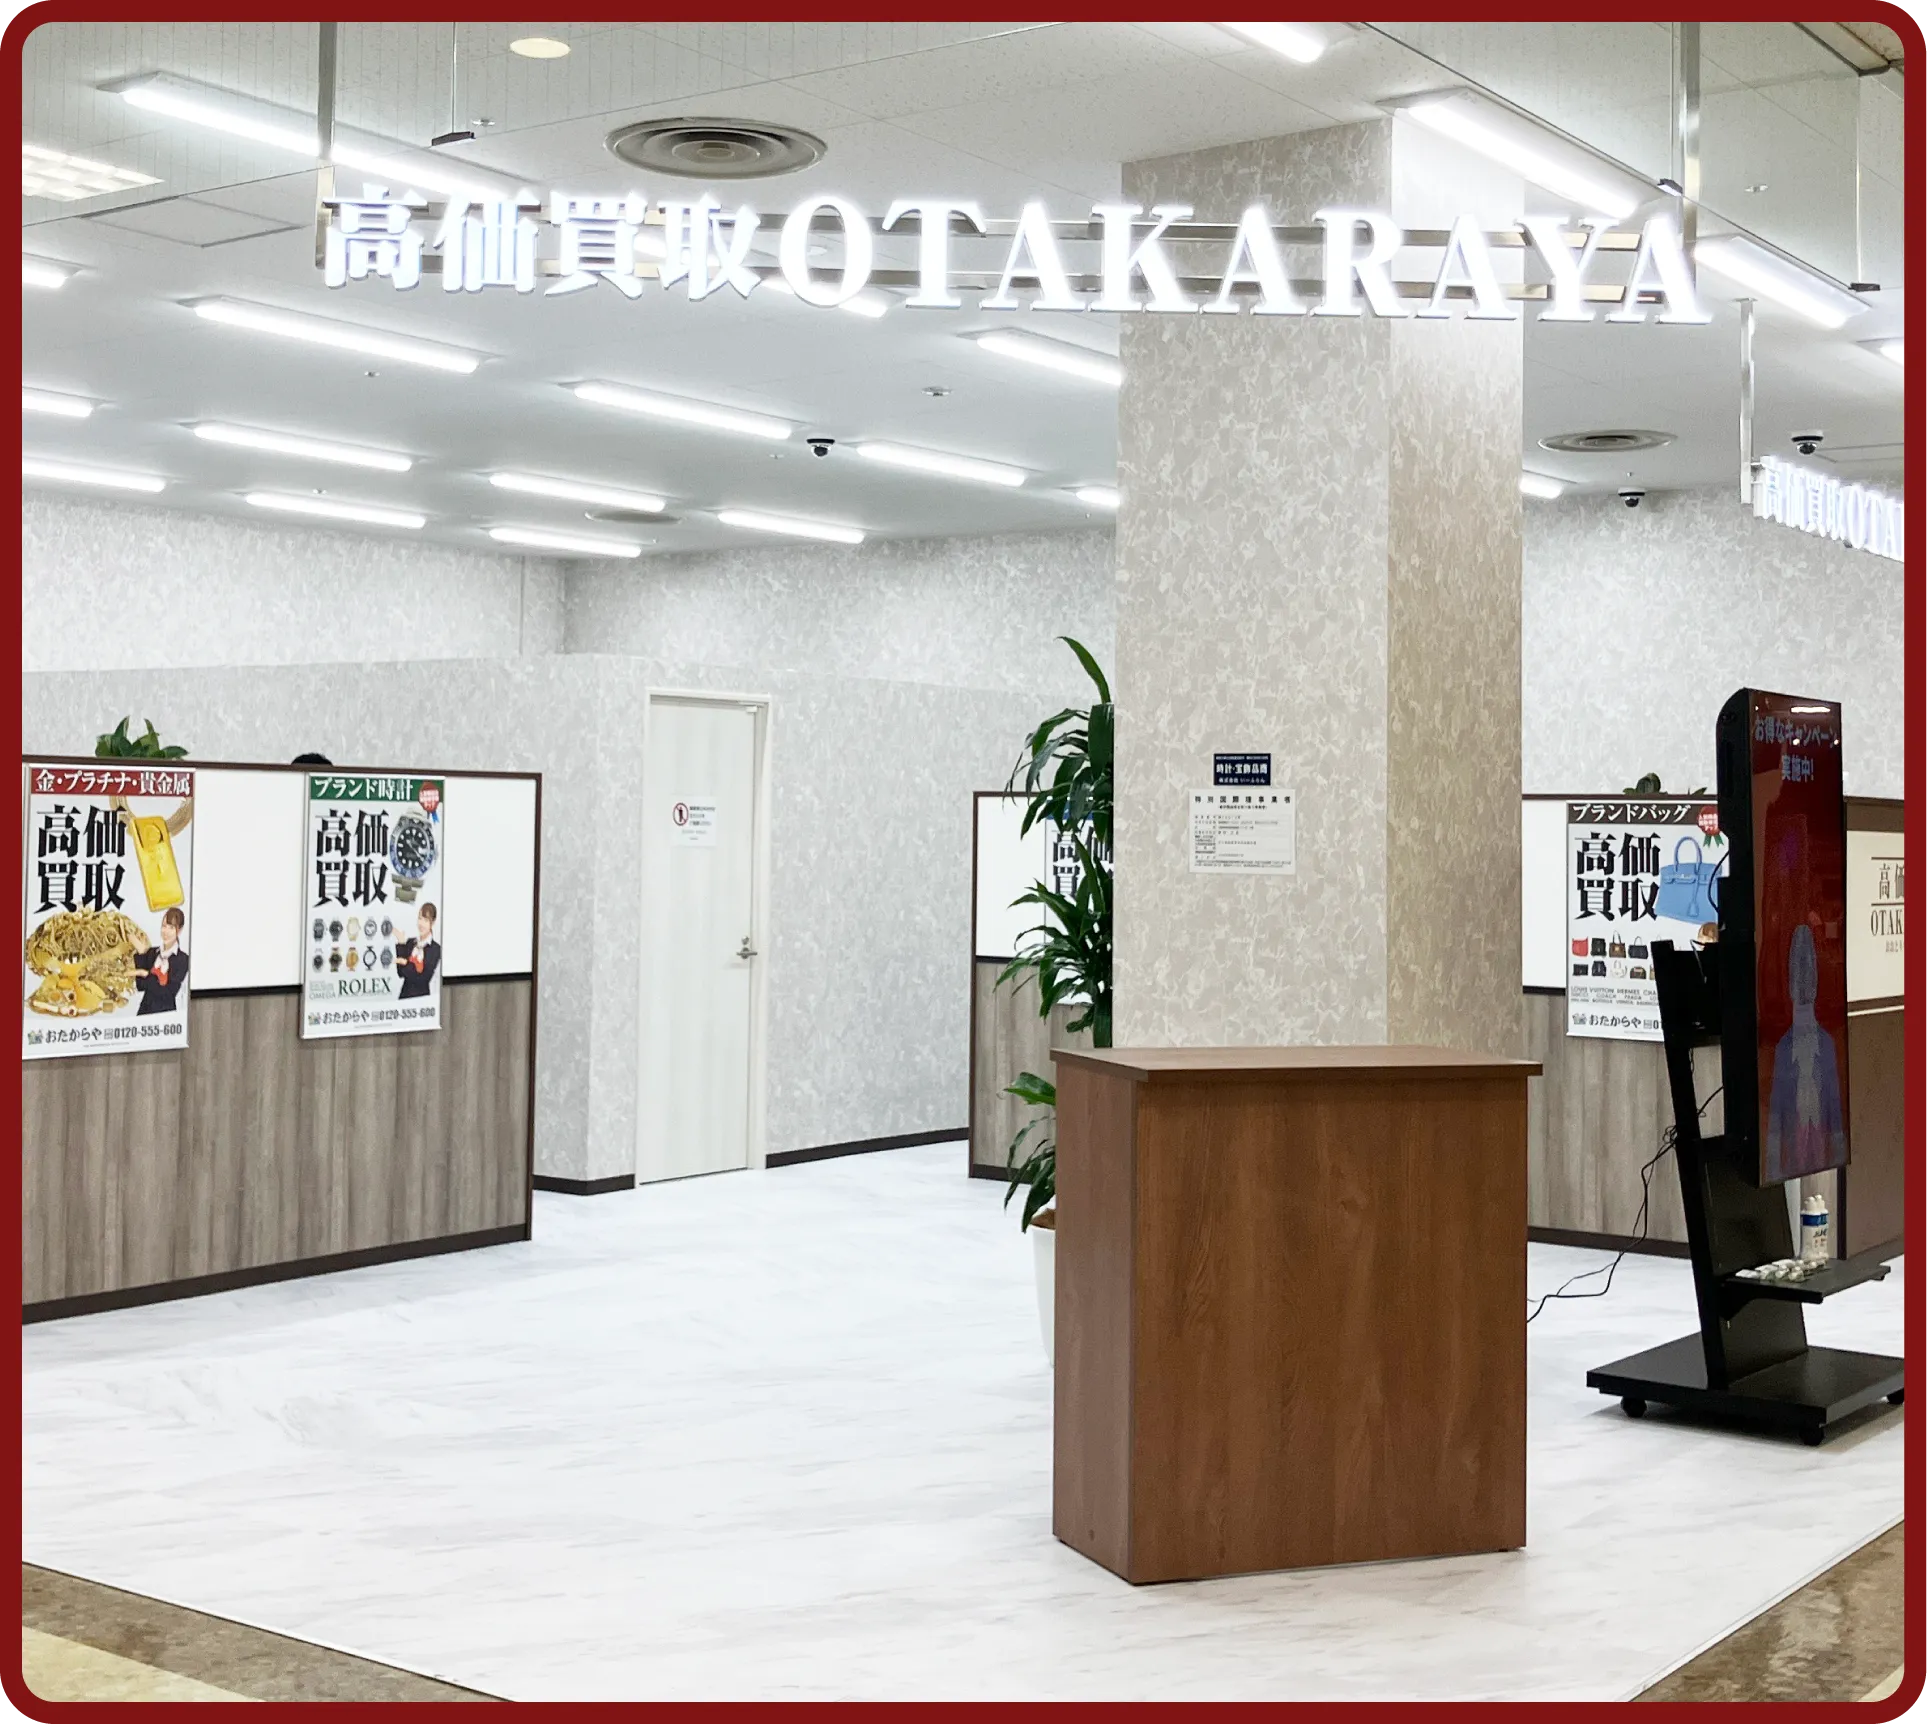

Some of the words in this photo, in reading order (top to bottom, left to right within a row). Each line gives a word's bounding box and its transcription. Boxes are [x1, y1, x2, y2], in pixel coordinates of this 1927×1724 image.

[35, 769, 191, 796] 金・プラチナ・貴金属
[314, 777, 413, 801] ブランド時計
[1572, 803, 1691, 824] ブランドバッグ
[36, 804, 127, 858] 高価
[314, 808, 389, 858] 高価
[1574, 832, 1661, 877] 高価
[34, 859, 126, 913] 買取
[313, 858, 388, 908] 買取
[1574, 877, 1660, 922] 買取
[1870, 909, 1904, 936] OTAK
[339, 977, 391, 997] ROLEX
[323, 1010, 370, 1025] おたからや
[1589, 1014, 1641, 1028] おたからや
[45, 1027, 102, 1043] おたからや
[114, 1023, 182, 1039] 0120-555-600
